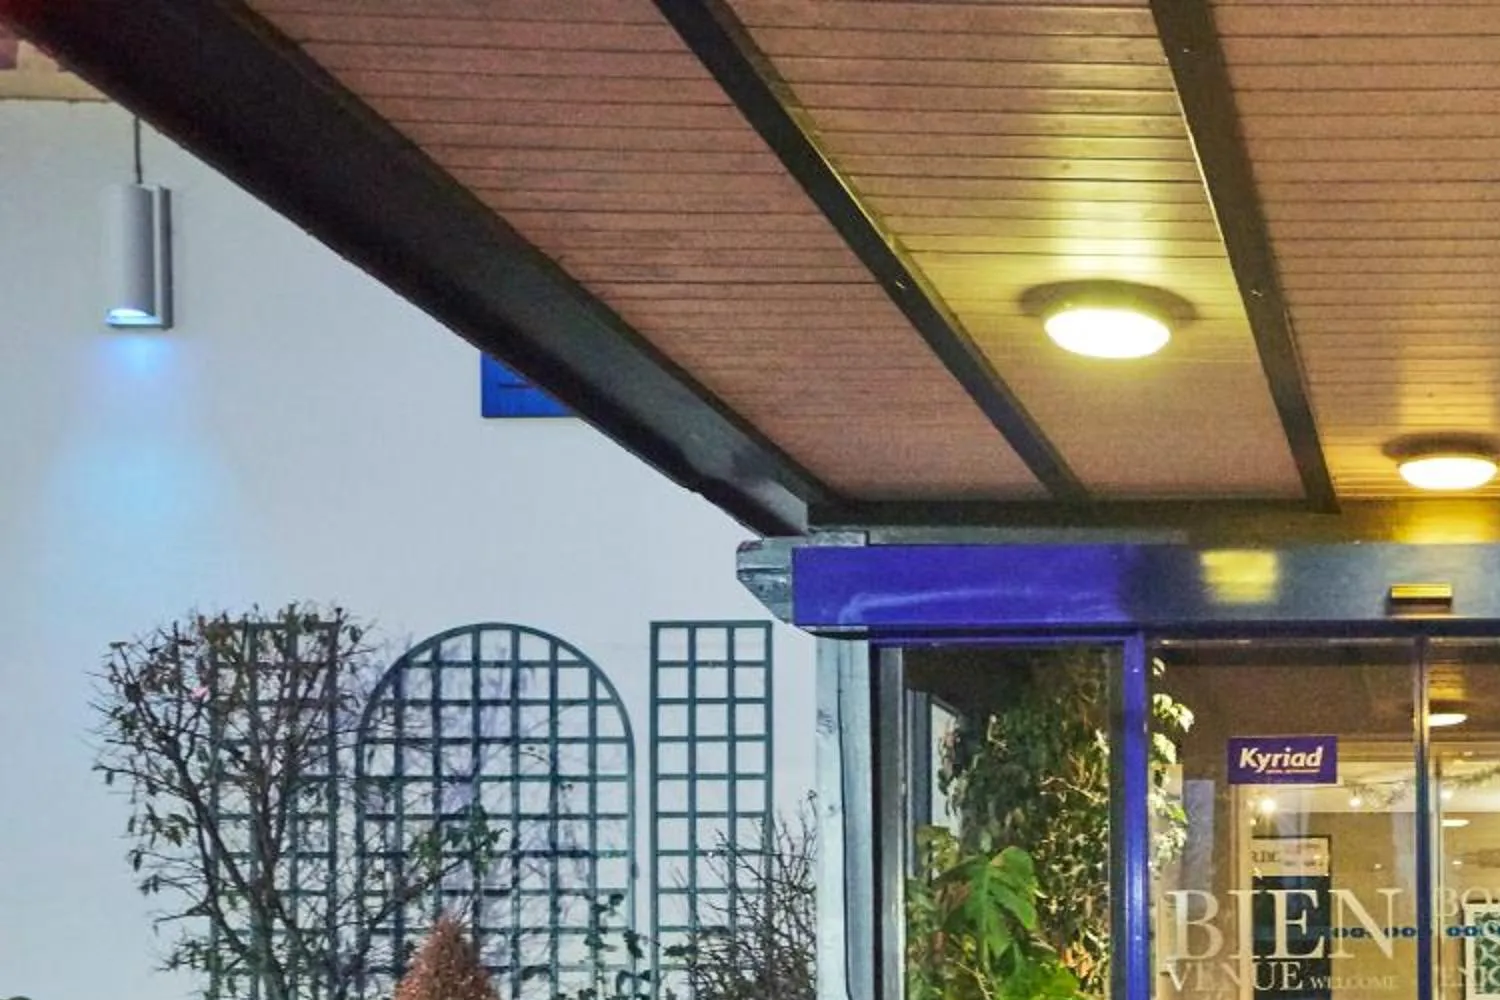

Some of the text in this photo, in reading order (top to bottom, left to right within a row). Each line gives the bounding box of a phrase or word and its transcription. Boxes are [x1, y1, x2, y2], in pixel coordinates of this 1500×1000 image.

[1239, 745, 1325, 773] Kyriad
[1165, 887, 1404, 960] BIEN
[1163, 961, 1400, 992] VENUE WELCOME
